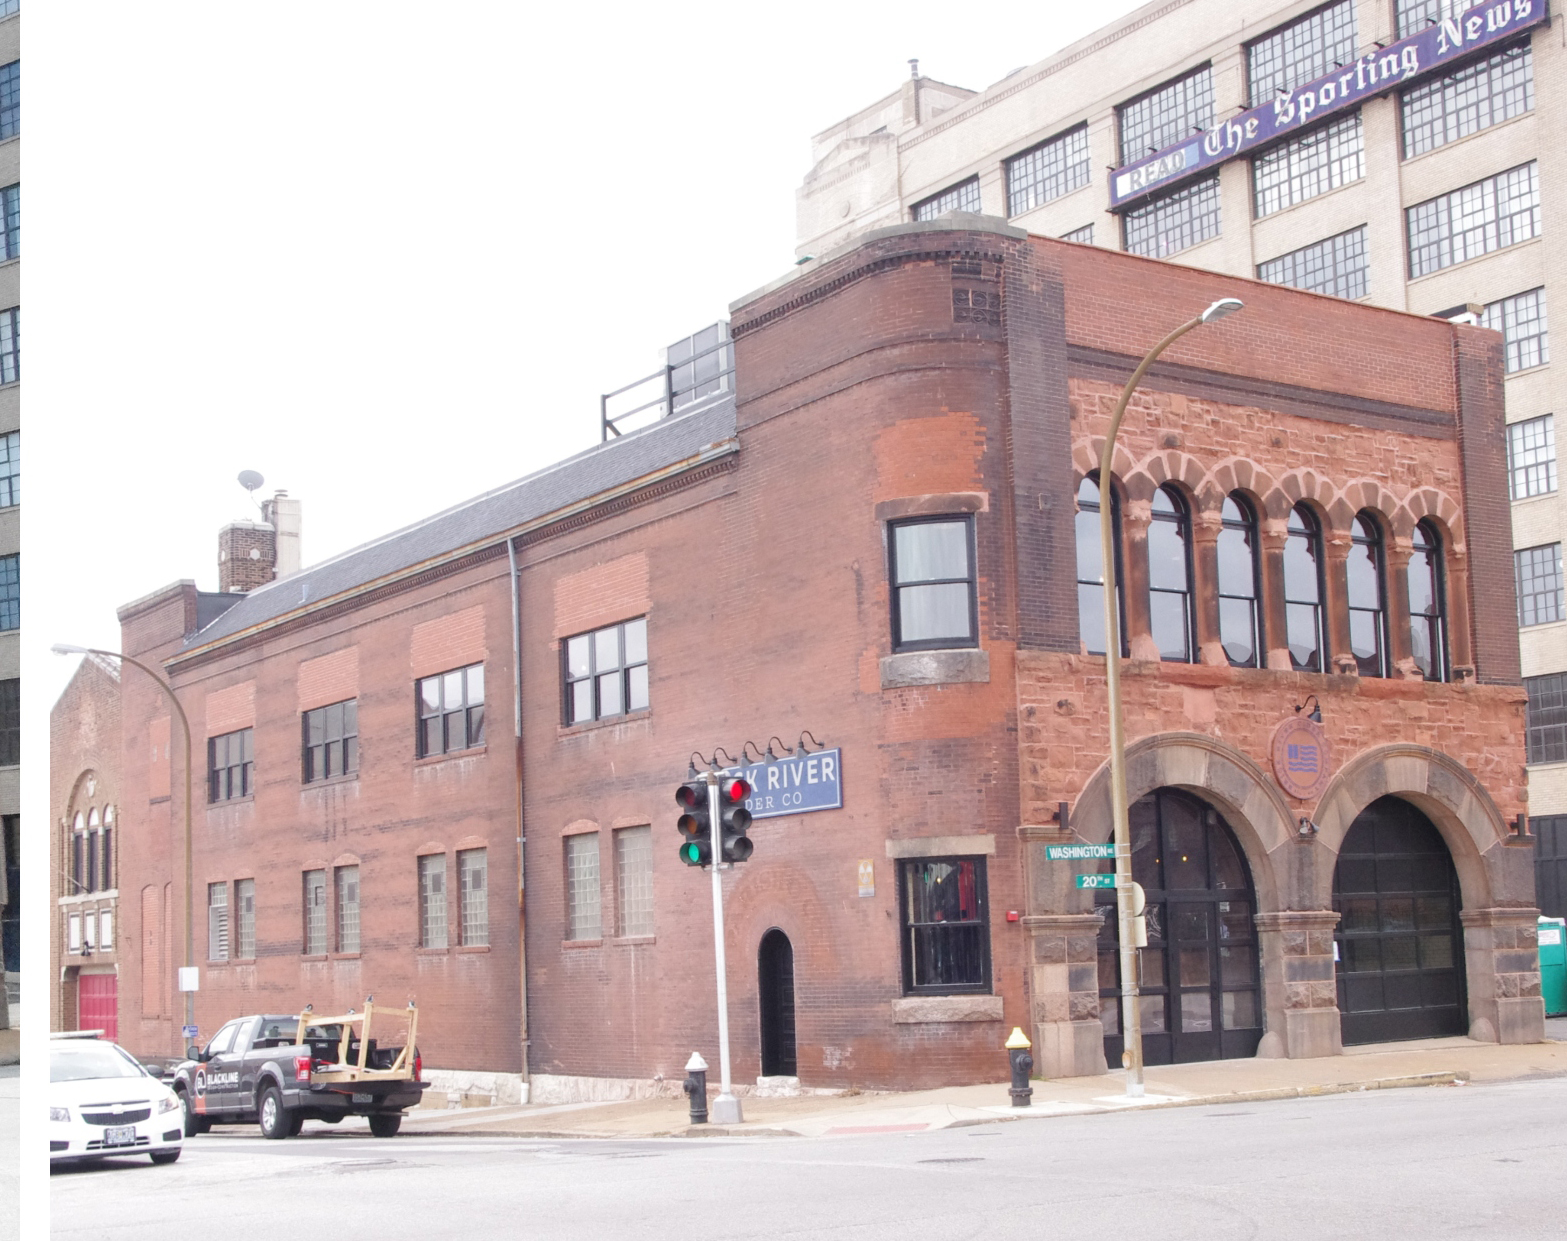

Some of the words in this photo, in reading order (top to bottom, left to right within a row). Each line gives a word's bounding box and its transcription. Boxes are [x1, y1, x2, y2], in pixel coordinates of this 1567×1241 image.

[1130, 151, 1184, 191] READ
[1204, 117, 1259, 155] The
[1274, 45, 1418, 127] Sporting
[1437, 0, 1532, 55] News
[767, 757, 836, 790] RIVER
[745, 796, 775, 811] DER
[782, 791, 802, 807] CO
[1049, 846, 1107, 858] WASHINGTON
[207, 1072, 239, 1084] BLACKLINE
